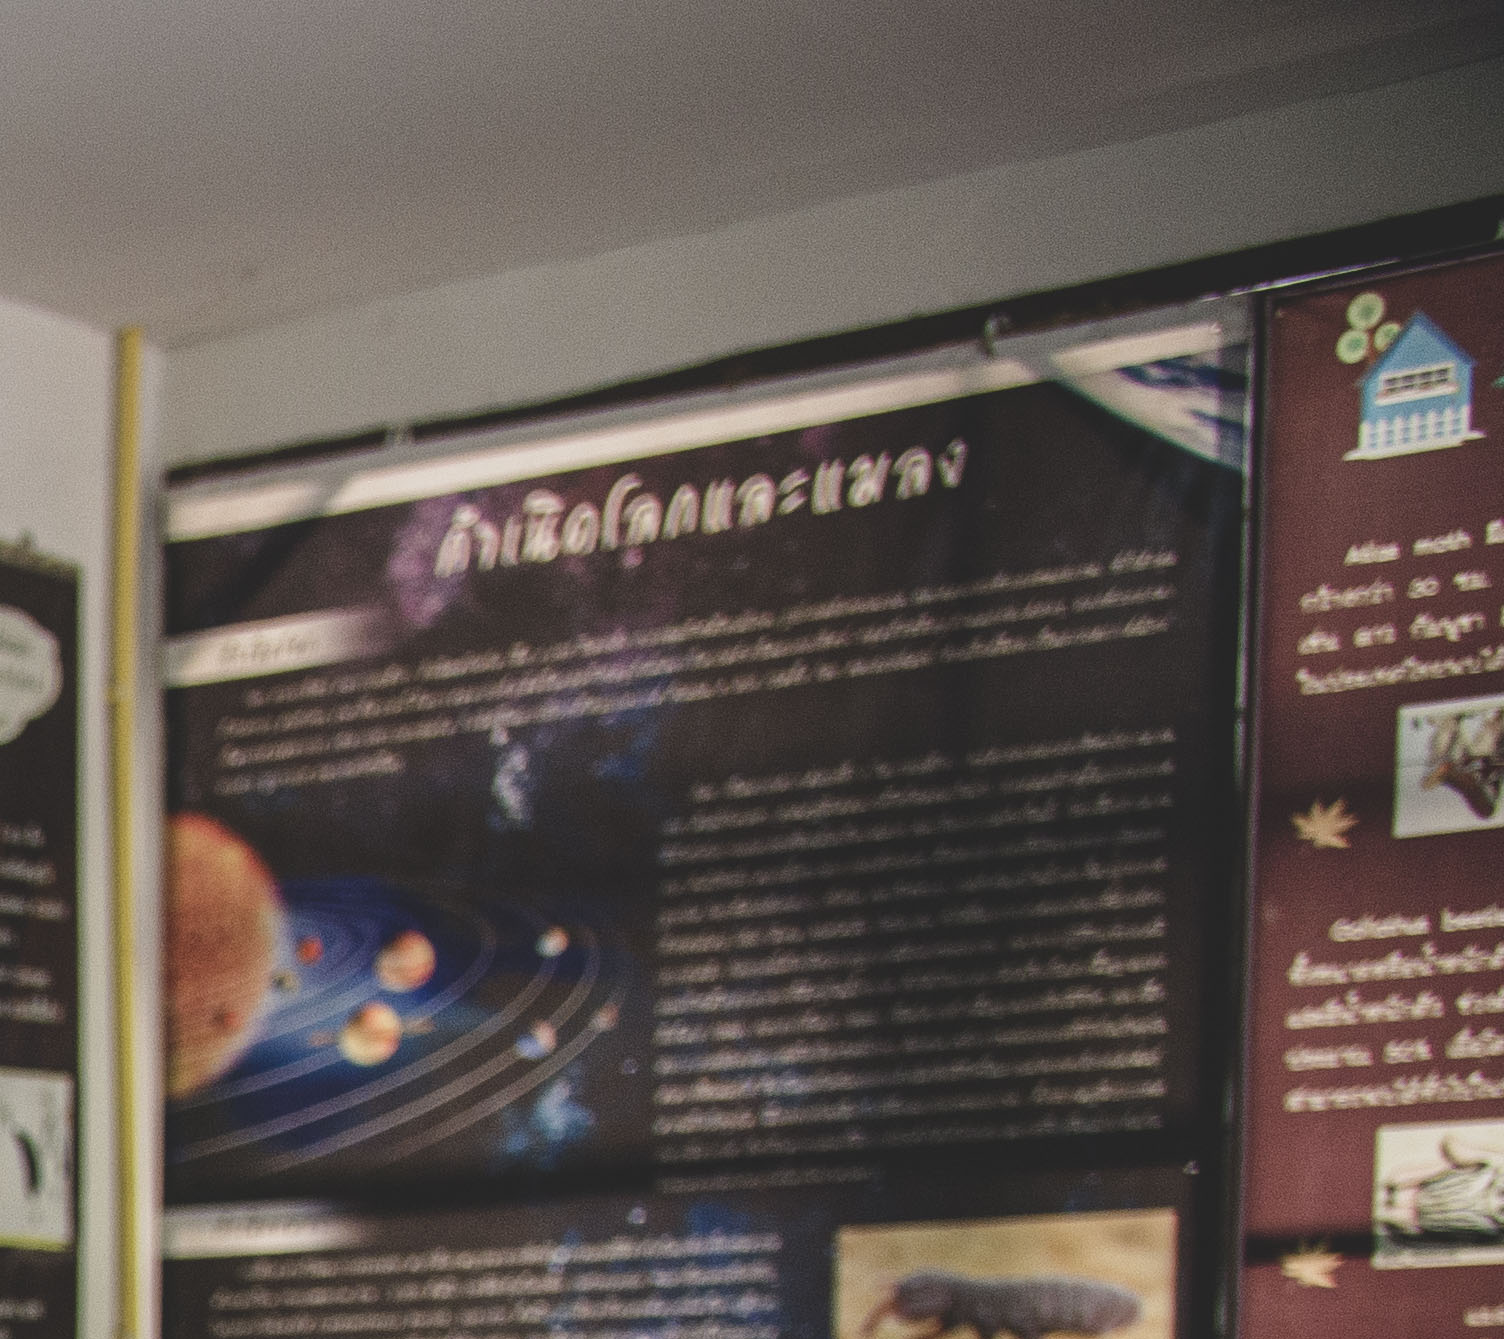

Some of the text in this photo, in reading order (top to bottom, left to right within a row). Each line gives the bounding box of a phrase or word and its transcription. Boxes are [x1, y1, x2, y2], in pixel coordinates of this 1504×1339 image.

[434, 434, 971, 580] กำเนิดโลกและแมลง
